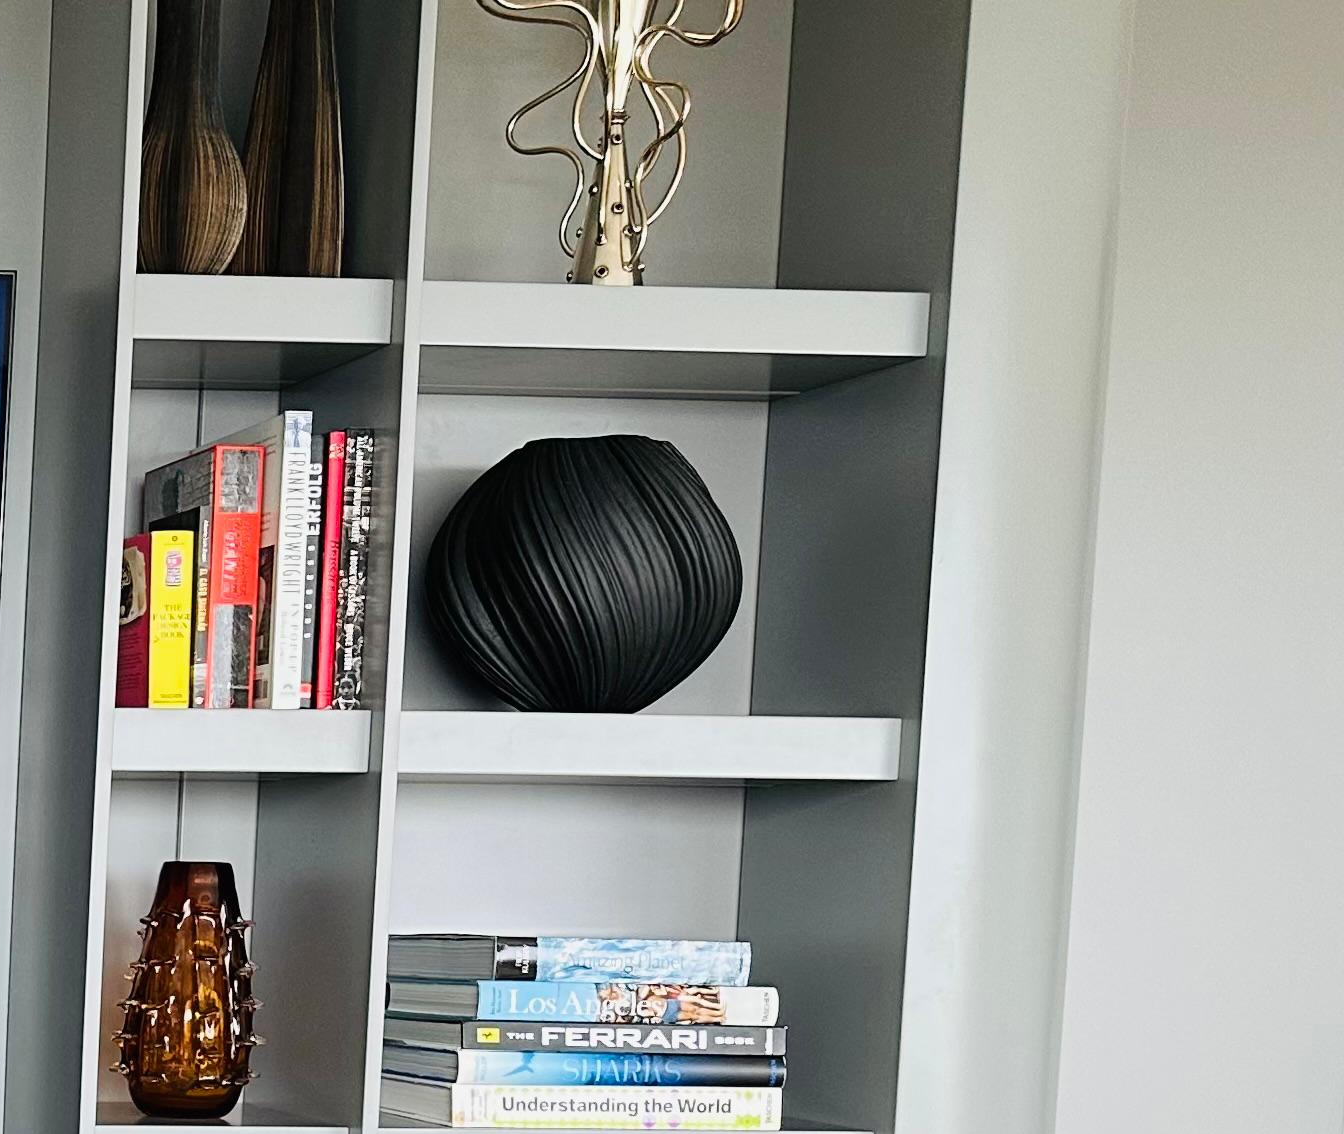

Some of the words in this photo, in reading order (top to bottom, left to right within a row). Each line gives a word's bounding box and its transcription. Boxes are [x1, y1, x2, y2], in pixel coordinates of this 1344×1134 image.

[307, 463, 323, 536] ERFOLG
[506, 1032, 534, 1040] THE
[541, 1027, 708, 1050] FERRARI
[563, 1058, 681, 1083] SHARKS
[502, 1097, 638, 1117] Understanding
[644, 1099, 673, 1114] the
[678, 1099, 732, 1114] World
